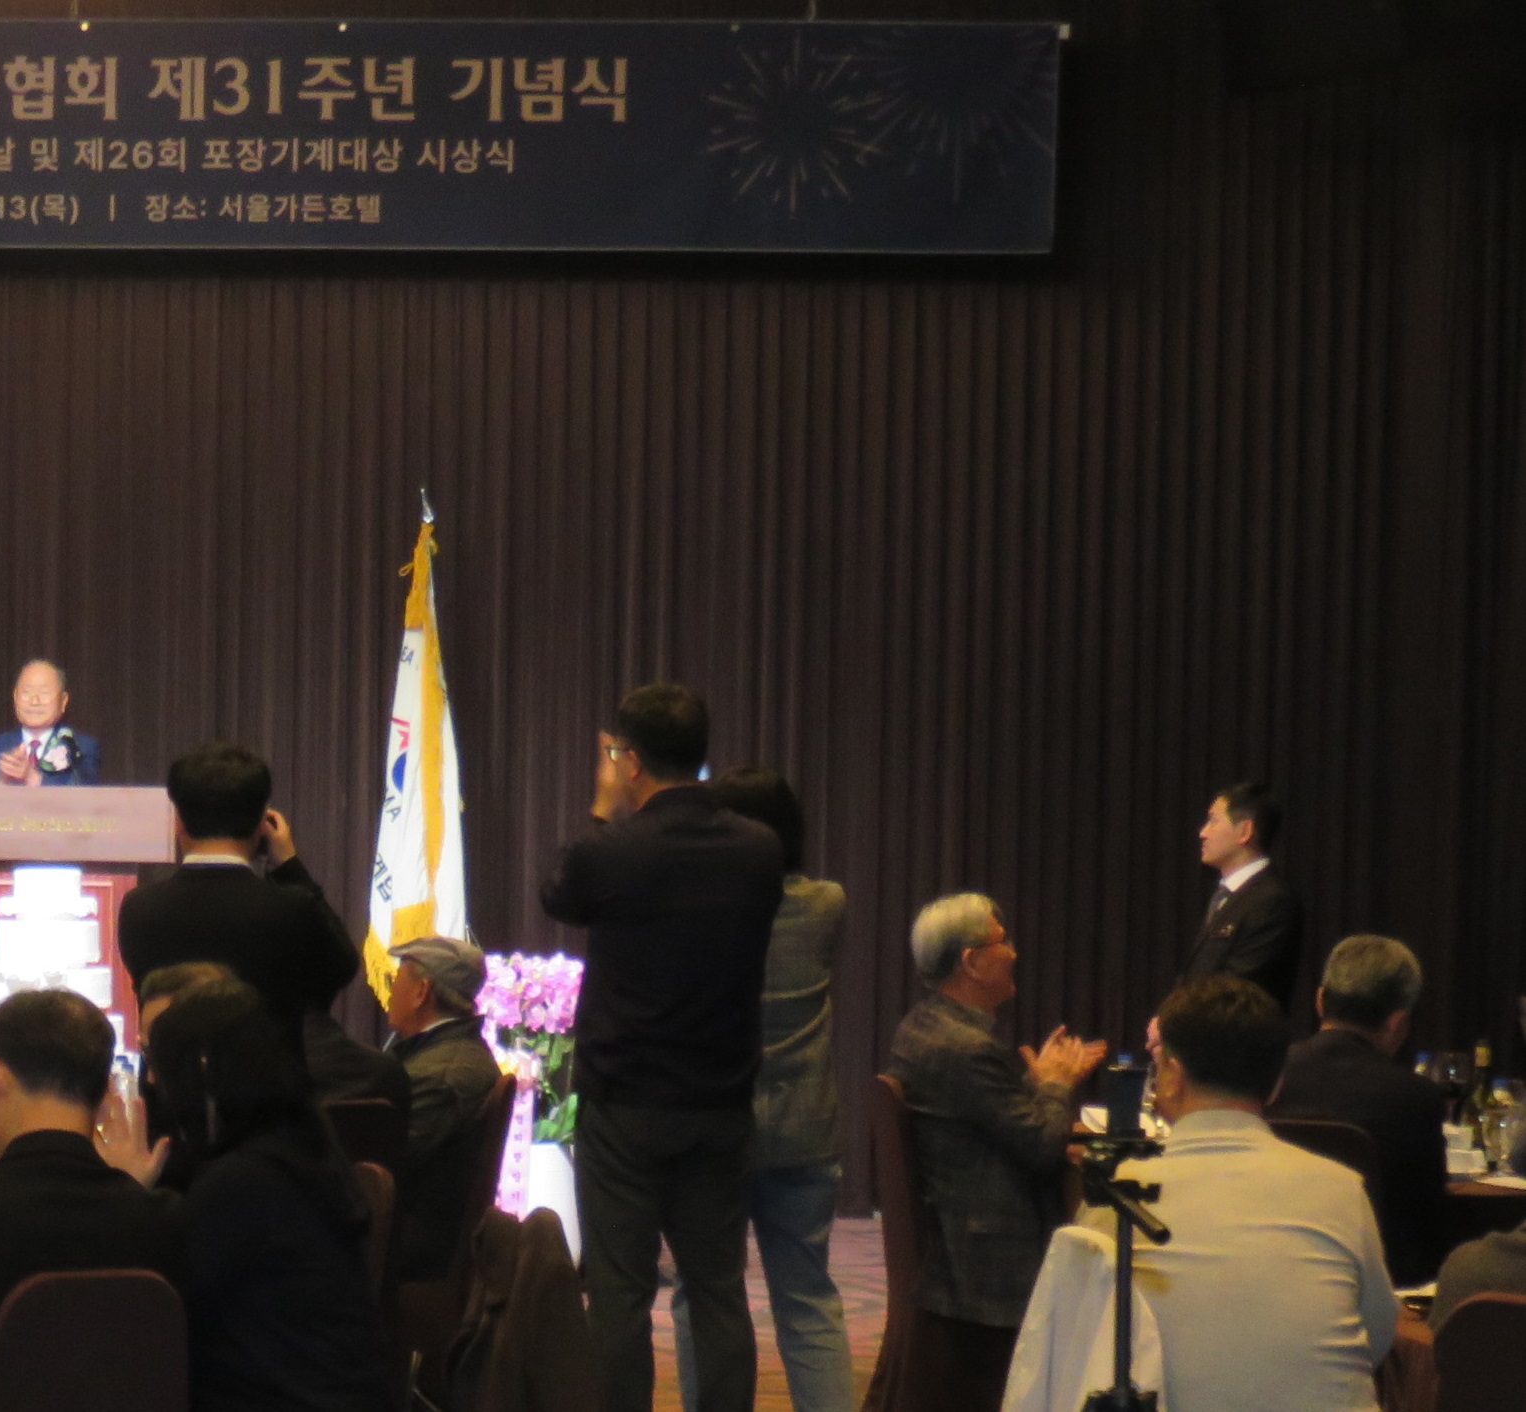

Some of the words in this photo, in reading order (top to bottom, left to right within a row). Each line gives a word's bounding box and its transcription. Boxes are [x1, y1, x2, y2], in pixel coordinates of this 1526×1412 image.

[149, 57, 415, 121] 제31주년
[451, 58, 628, 122] 기념식
[31, 139, 58, 171] 및
[74, 138, 186, 171] 제26회
[202, 138, 403, 173] 포장기계대상
[417, 139, 515, 173] 시상식
[146, 194, 206, 222] 장소:
[219, 193, 381, 223] 서울가든호텔
